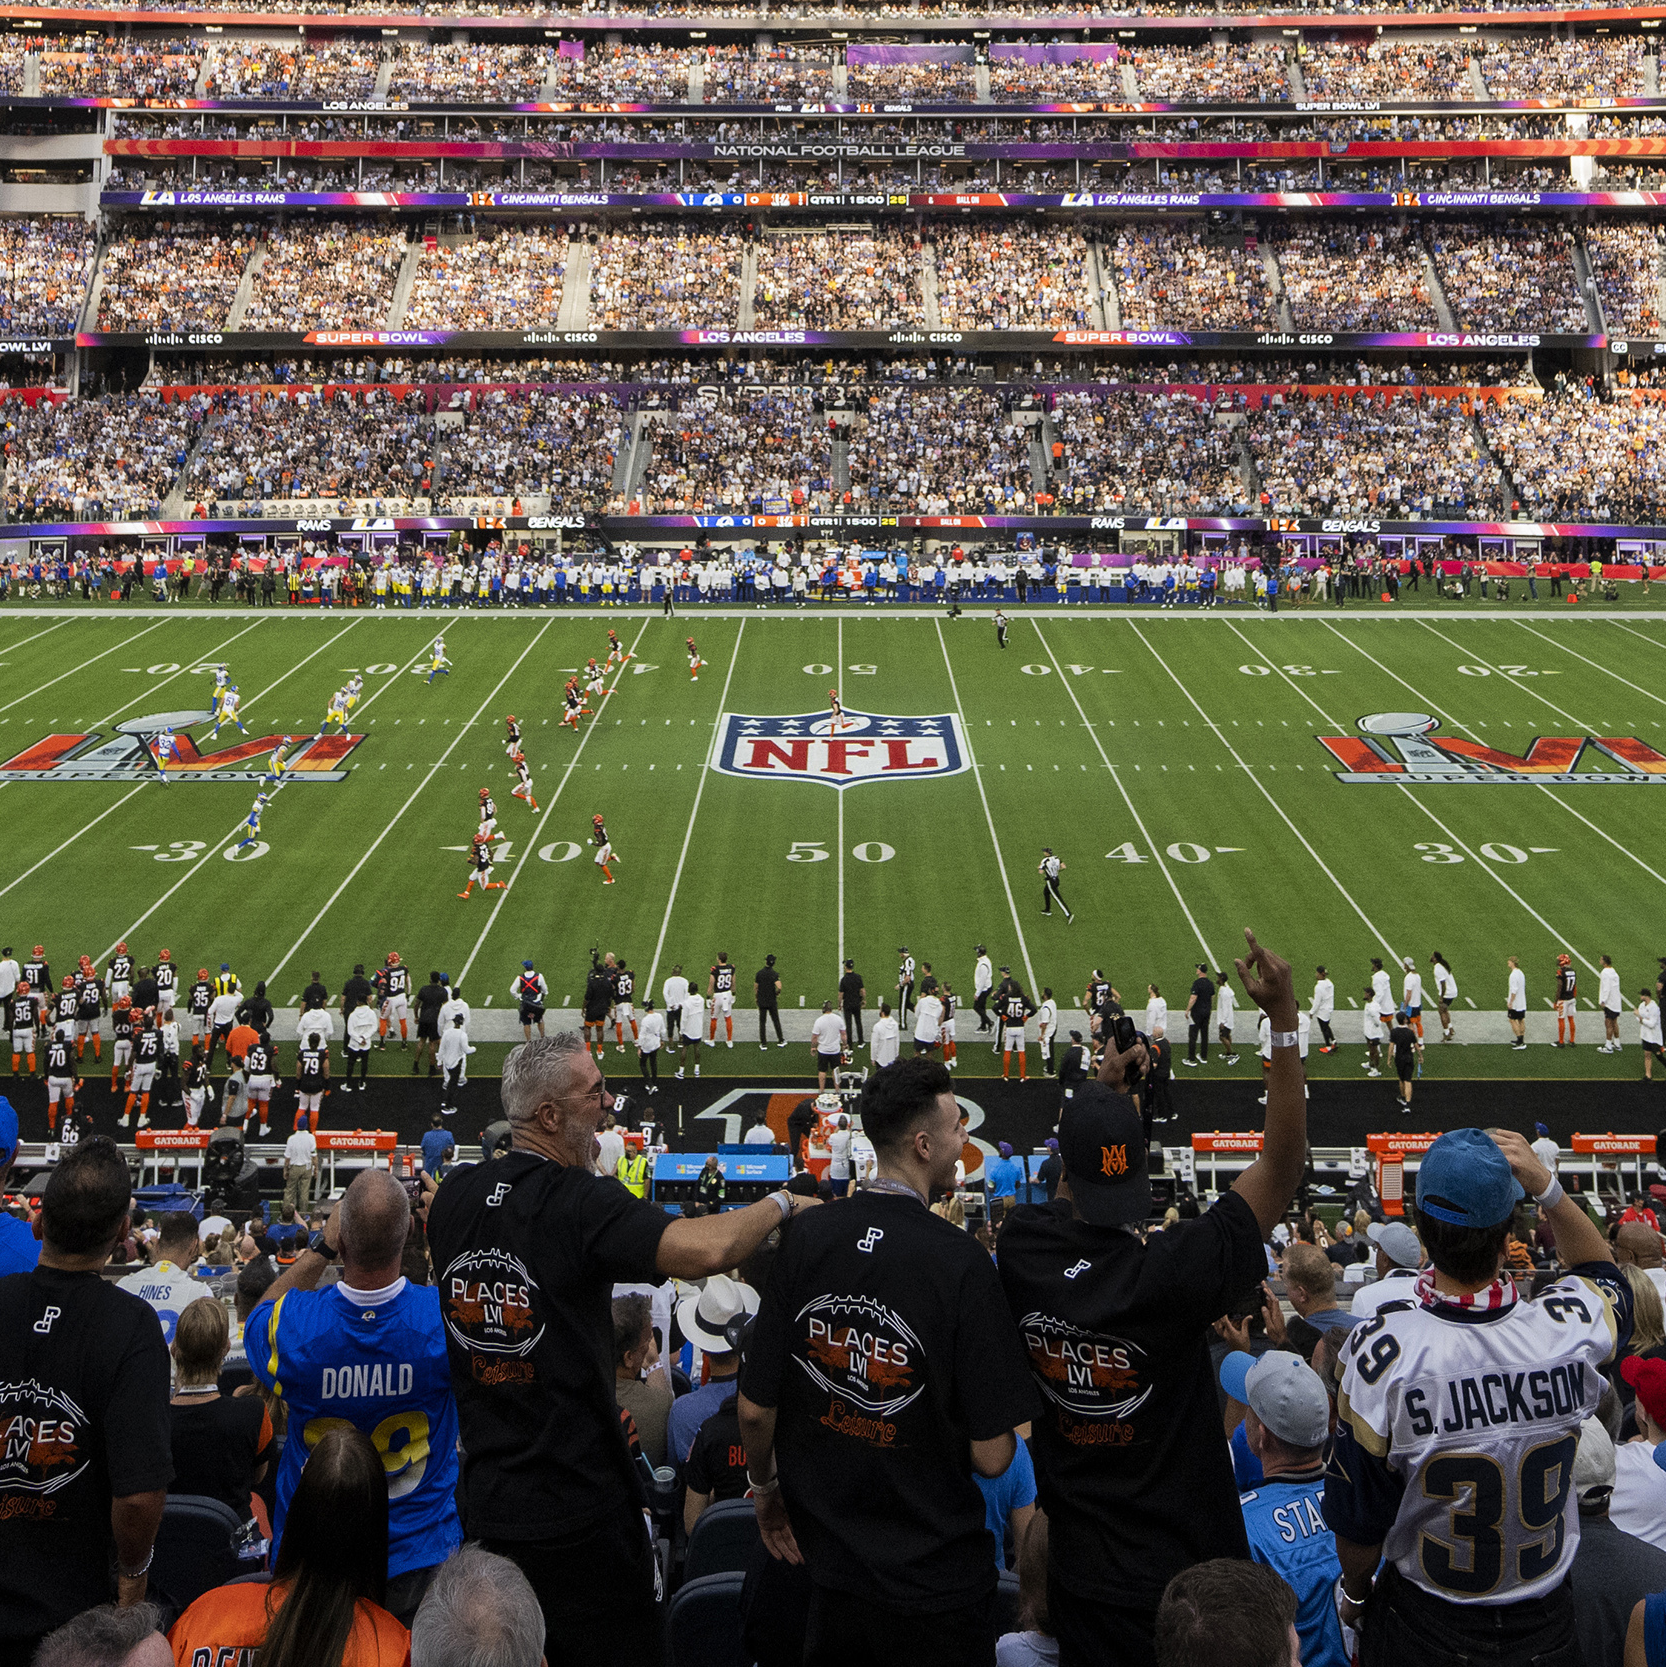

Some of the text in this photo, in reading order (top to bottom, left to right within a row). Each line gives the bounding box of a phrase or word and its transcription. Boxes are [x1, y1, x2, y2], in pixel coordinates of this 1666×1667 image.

[713, 144, 966, 157] NATIONAL FOOTBALL LEAGUE
[501, 193, 609, 206] CINCINNATI BENGALS
[1098, 193, 1200, 205] LOS ANGELES RAMS
[1427, 192, 1541, 206] CINCINNATI BENGALS
[188, 333, 223, 344] CISCO
[316, 332, 429, 343] SUPER BOWL
[564, 332, 598, 343] CISCO
[698, 332, 806, 343] LOS ANGELES
[929, 332, 963, 343] CISCO
[1065, 332, 1177, 344] SUPER BOWL
[1299, 334, 1334, 345] CISCO
[1426, 334, 1541, 347] LOS ANGELES
[296, 519, 332, 533] RAMS
[527, 515, 585, 529] BENGALS
[1091, 517, 1125, 531] RAMS
[1321, 519, 1381, 534] BENGALS
[744, 737, 936, 775] NFL
[785, 841, 896, 863] 50
[1105, 841, 1211, 864] 40
[1413, 842, 1529, 864] 30
[113, 964, 131, 979] 22
[389, 977, 406, 992] 94
[1006, 1002, 1024, 1019] 46
[140, 1037, 158, 1055] 75
[48, 1049, 67, 1068] 70
[249, 1053, 267, 1072] 63
[302, 1057, 321, 1075] 79
[154, 1135, 201, 1147] GATORADE
[329, 1136, 377, 1147] GATORADE
[1212, 1138, 1259, 1149] GATORADE
[1592, 1140, 1641, 1151] GATORADE
[139, 1284, 171, 1302] HINES
[451, 1277, 531, 1309] PLACES
[483, 1304, 504, 1324] LVI
[808, 1316, 910, 1366] PLACES
[1025, 1333, 1132, 1371] PLACES
[472, 1354, 536, 1387] Leisure
[849, 1350, 868, 1377] LVI
[321, 1362, 414, 1400] DONALD
[1067, 1363, 1093, 1389] LVI
[819, 1400, 898, 1444] Leisure
[1059, 1411, 1134, 1446] Leisure
[4, 1437, 31, 1463] LVI
[1421, 1434, 1579, 1596] 39
